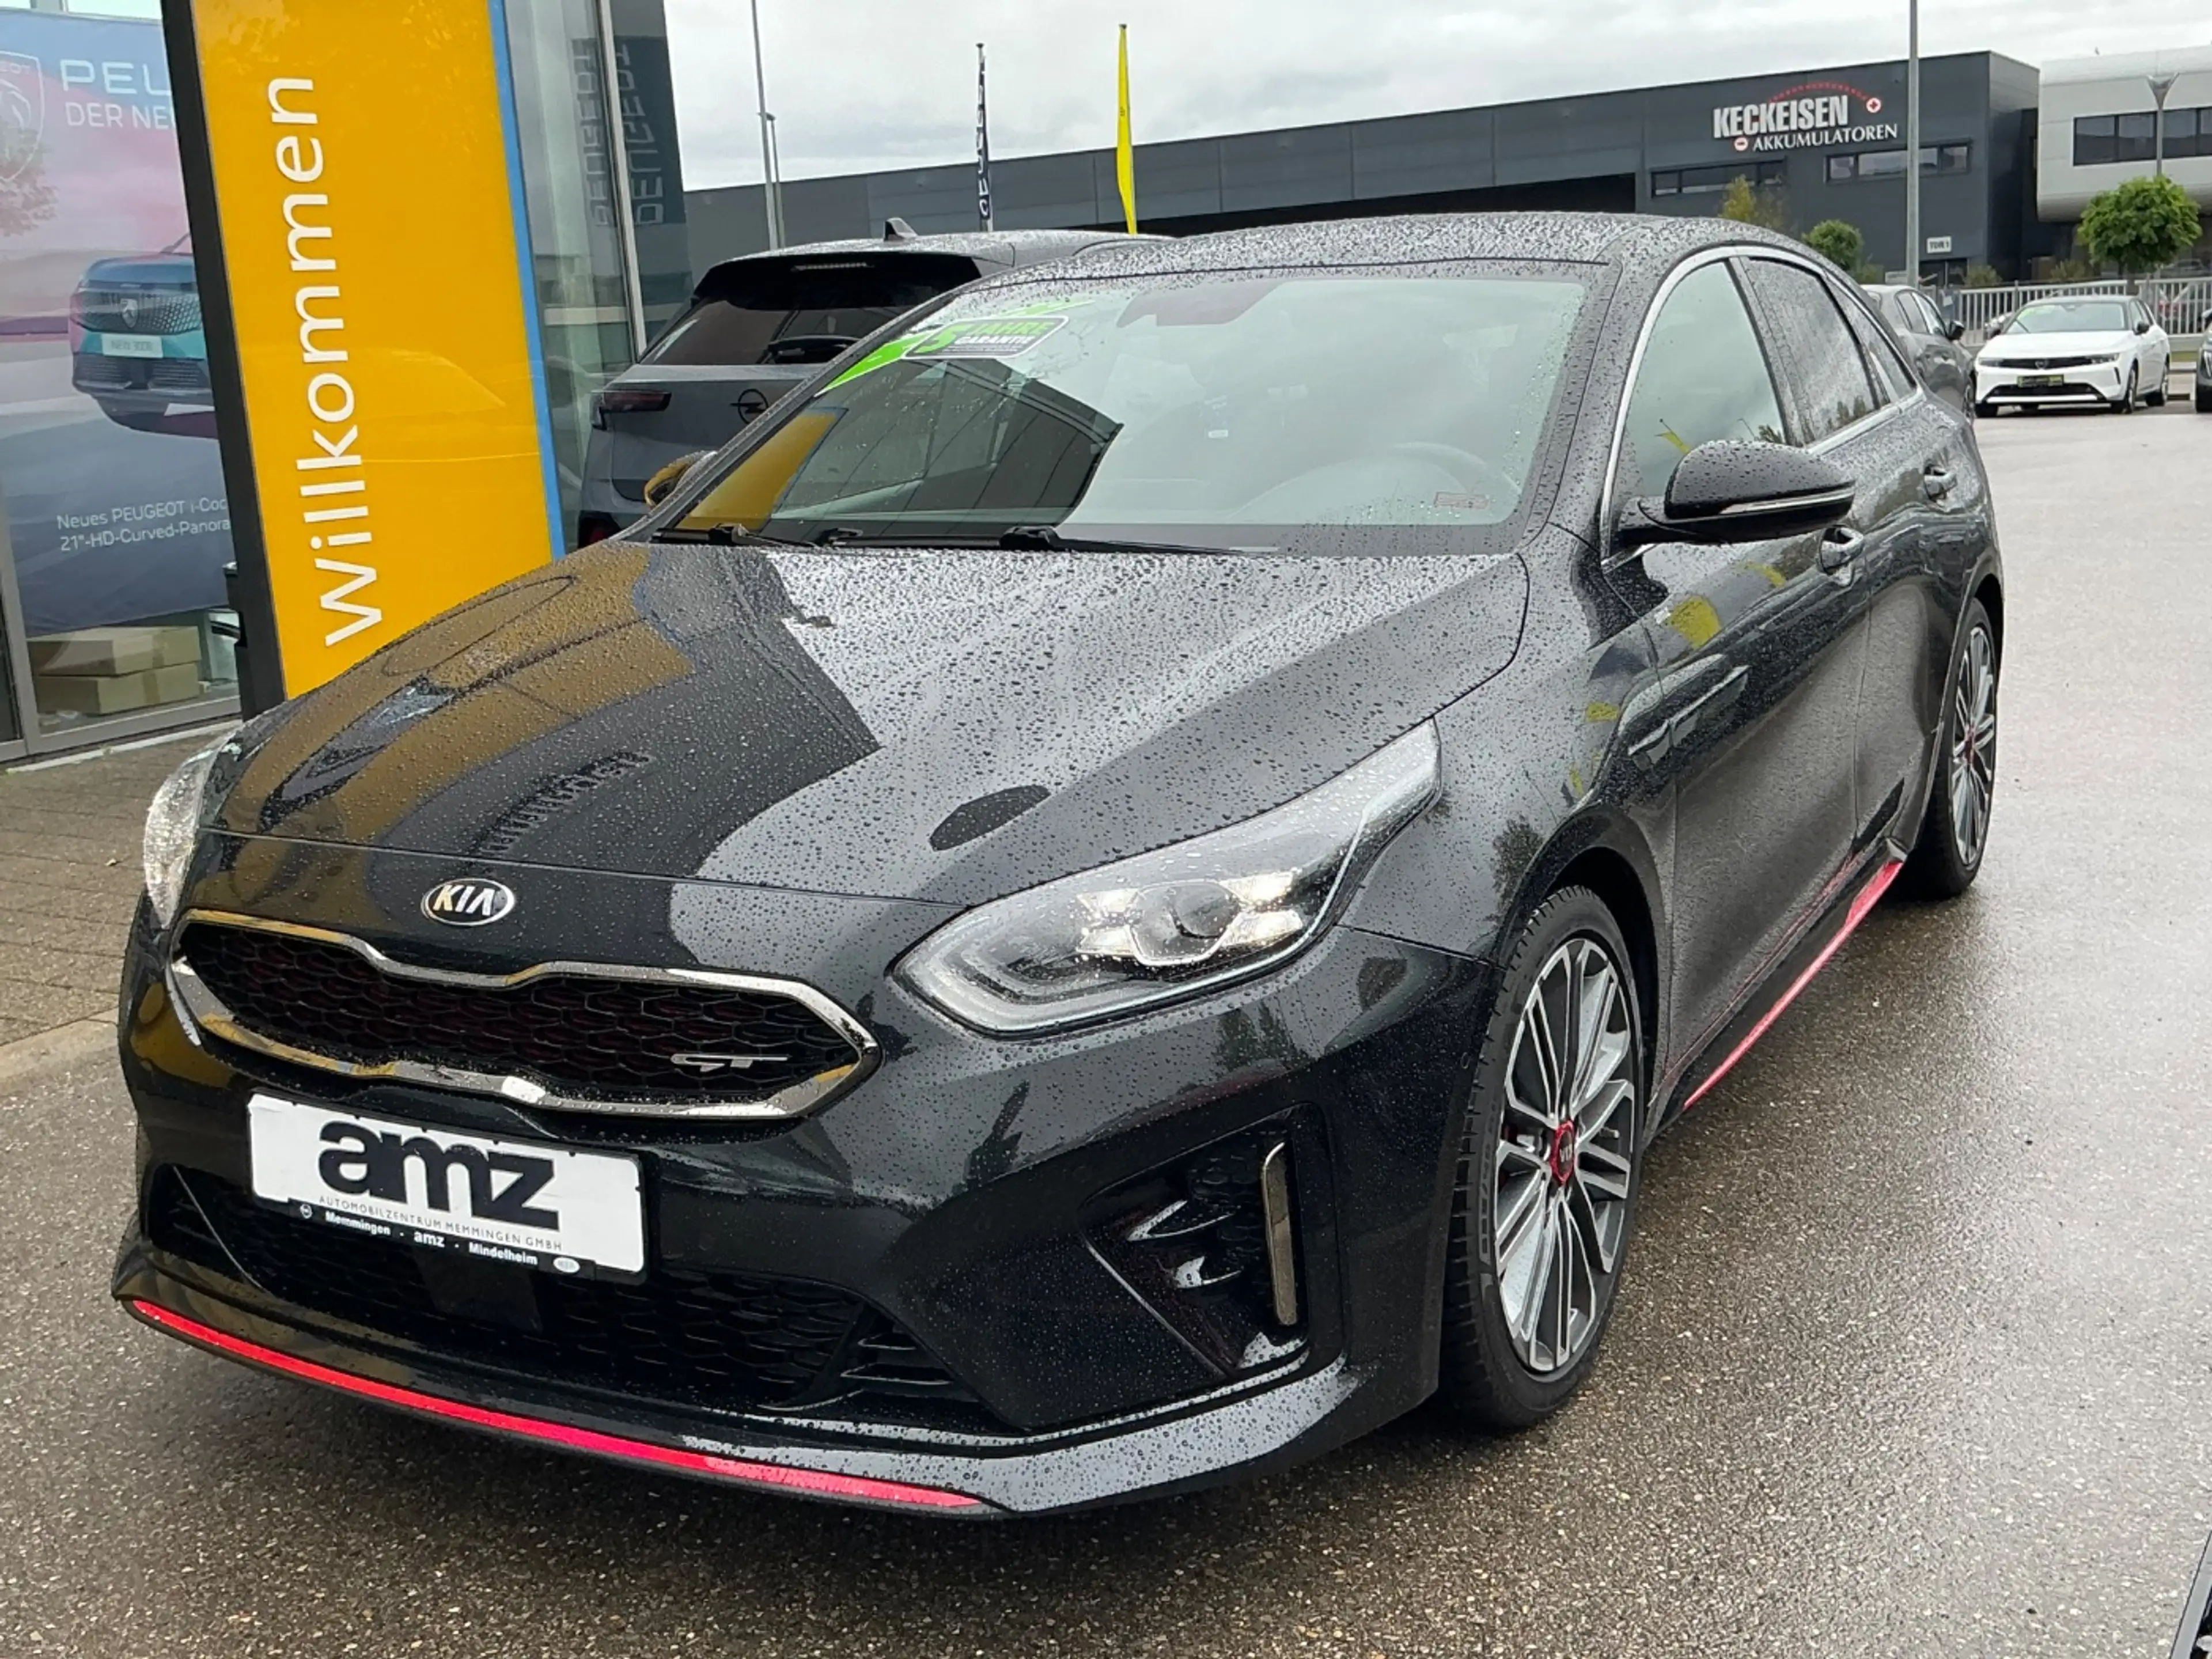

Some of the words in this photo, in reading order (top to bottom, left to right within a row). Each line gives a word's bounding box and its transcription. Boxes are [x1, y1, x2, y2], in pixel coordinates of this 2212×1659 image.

[65, 101, 123, 127] DER
[132, 104, 171, 130] NE
[1714, 95, 1848, 138] KECKEISEN
[1753, 124, 1897, 152] AKKUMULATOREN
[914, 324, 974, 353] 5
[965, 323, 1055, 335] JAHRE
[267, 77, 382, 646] Willkommen
[57, 513, 108, 529] Neues
[112, 501, 185, 522] PEUGEOT
[433, 884, 495, 916] KIA
[318, 1121, 560, 1232] amz
[319, 1195, 442, 1229] AUTOMOBILZENTRUM
[445, 1222, 521, 1244] MEMMINGEN
[525, 1236, 562, 1251] GMBH
[325, 1211, 391, 1236] Memmingen
[414, 1230, 445, 1248] amz
[469, 1242, 538, 1265] Mindelheim
